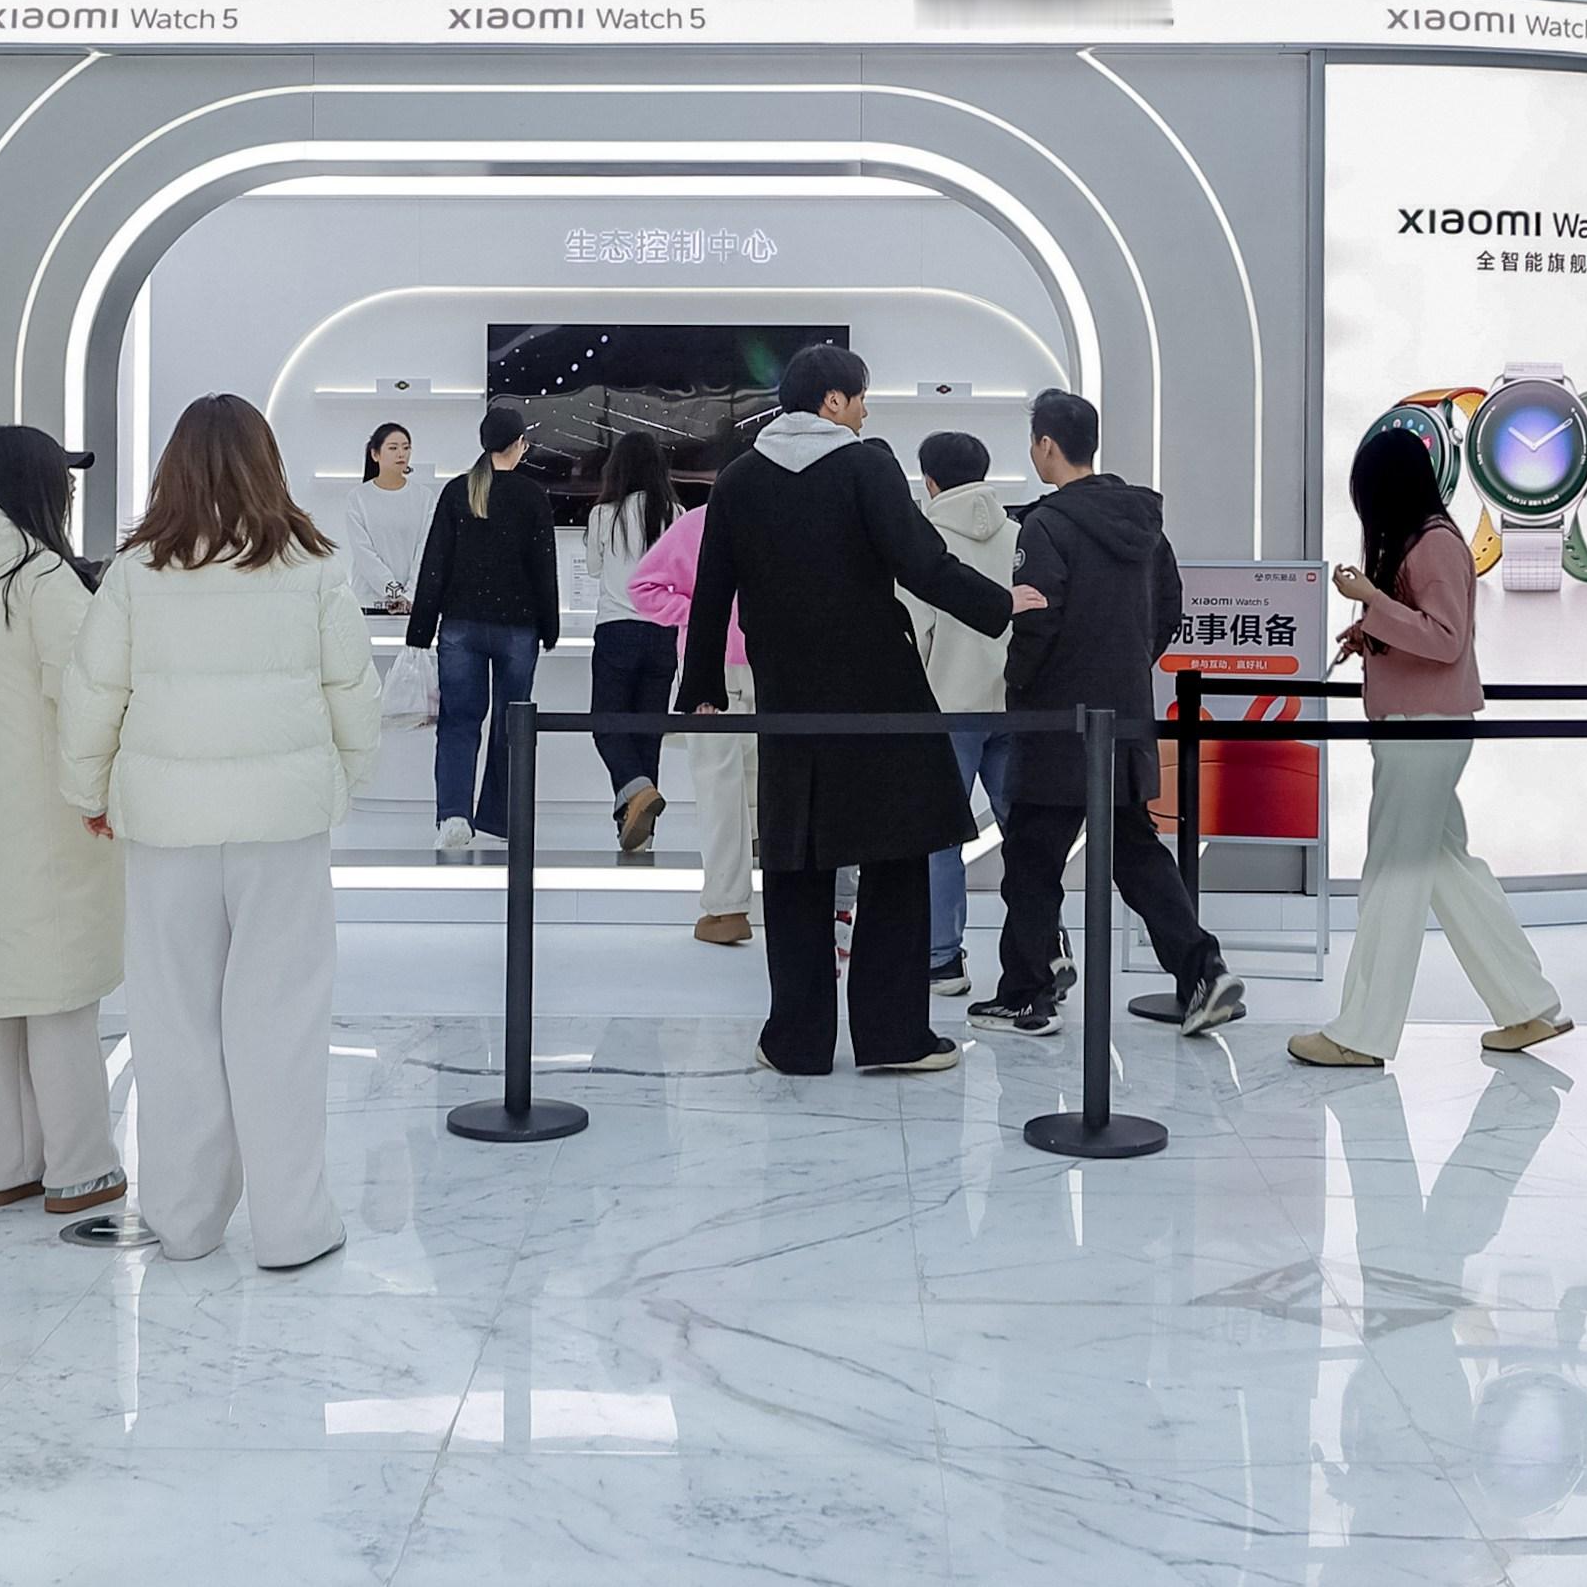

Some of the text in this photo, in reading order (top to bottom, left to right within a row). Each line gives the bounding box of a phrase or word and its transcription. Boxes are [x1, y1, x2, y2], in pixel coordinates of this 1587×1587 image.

[131, 8, 215, 29] Watch
[223, 8, 237, 29] 5
[596, 8, 682, 29] Watch
[691, 8, 705, 29] 5
[564, 228, 777, 263] 生态控制中心
[1477, 251, 1587, 273] 全智能旗舰
[1235, 598, 1262, 606] Watch
[1264, 598, 1269, 606] 5
